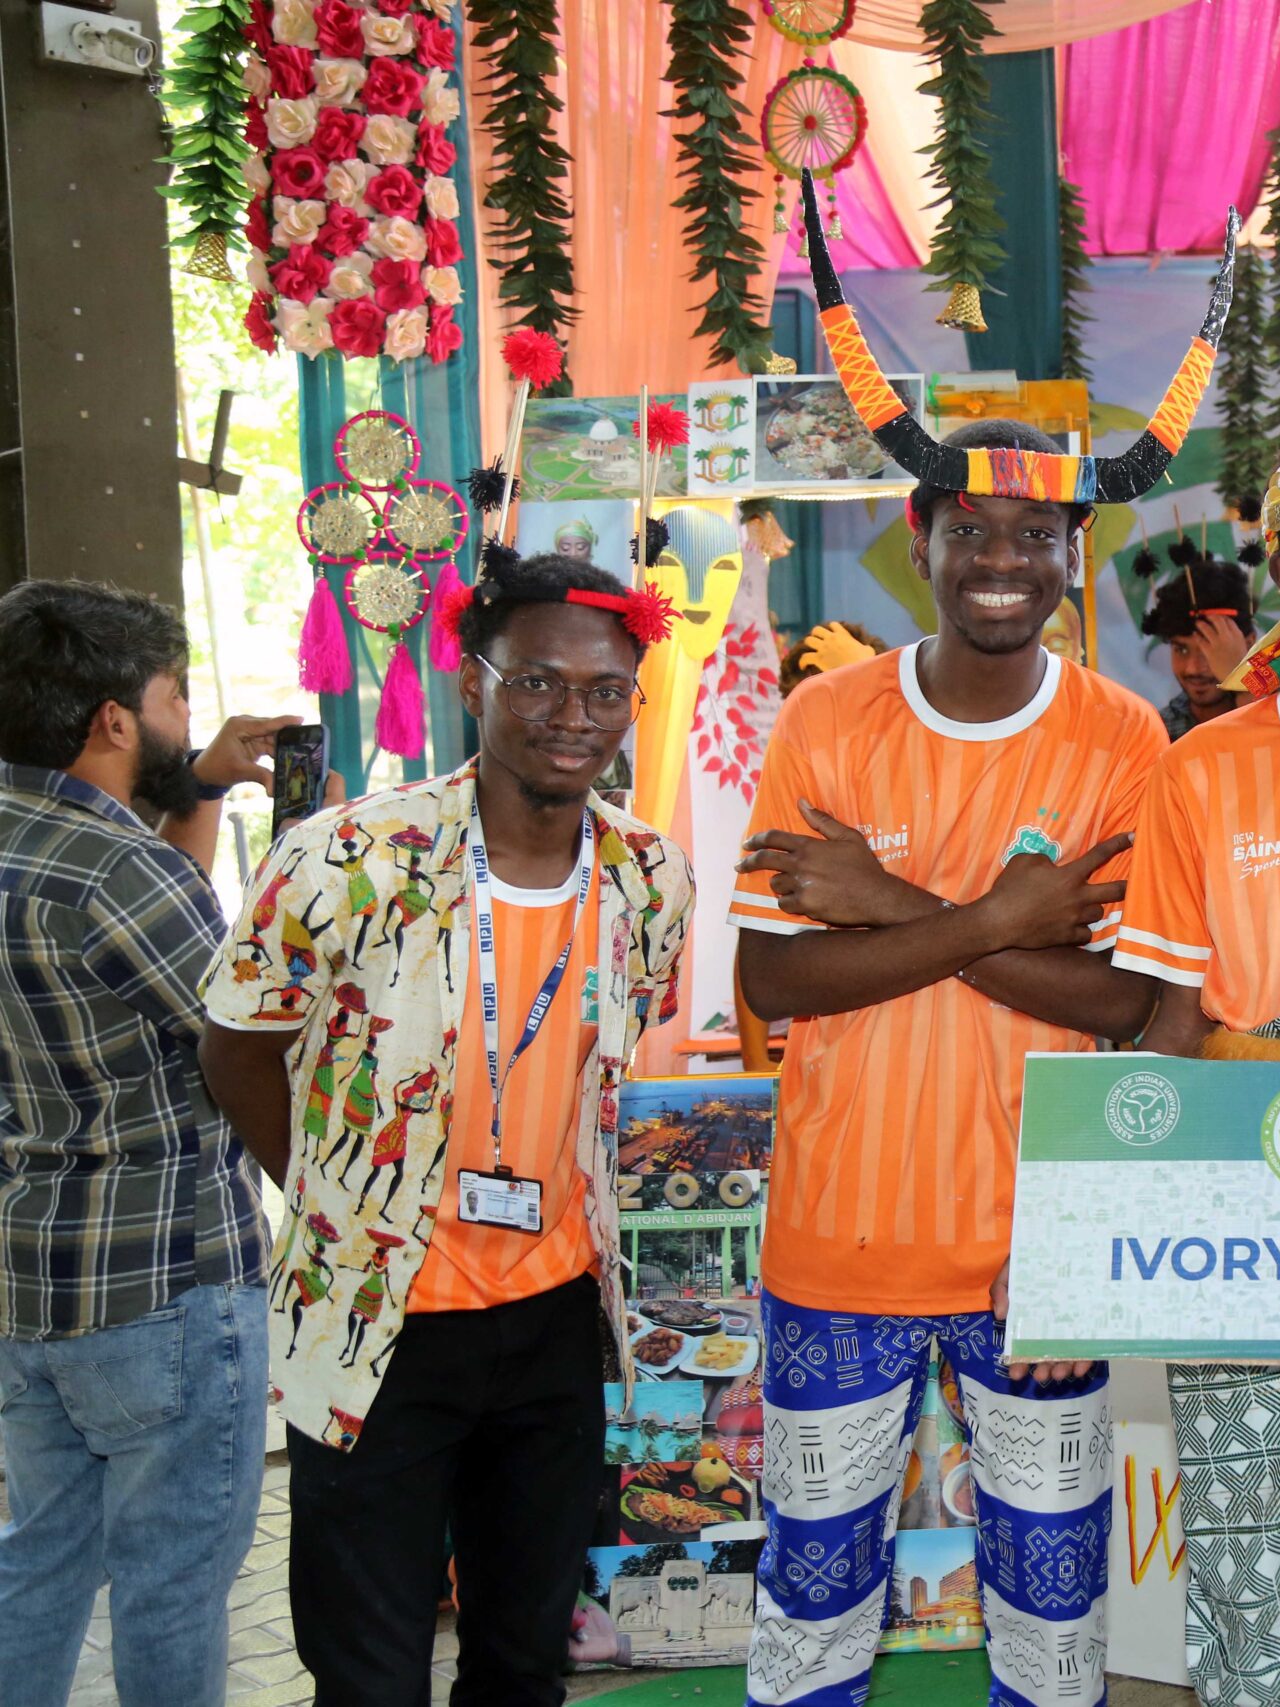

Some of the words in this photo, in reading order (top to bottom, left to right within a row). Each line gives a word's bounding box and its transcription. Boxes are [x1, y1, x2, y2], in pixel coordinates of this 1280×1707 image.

[472, 845, 488, 883] LPU
[479, 913, 493, 952] LPU
[482, 982, 497, 1022] LPU
[527, 992, 551, 1032] LPU
[1121, 1078, 1134, 1088] OF
[1135, 1075, 1166, 1087] INDIAN
[1108, 1087, 1134, 1140] ASSOCIATION
[1149, 1086, 1177, 1140] UNIVERSITIES
[617, 1172, 753, 1209] ZOO
[621, 1214, 678, 1225] ATIONAL
